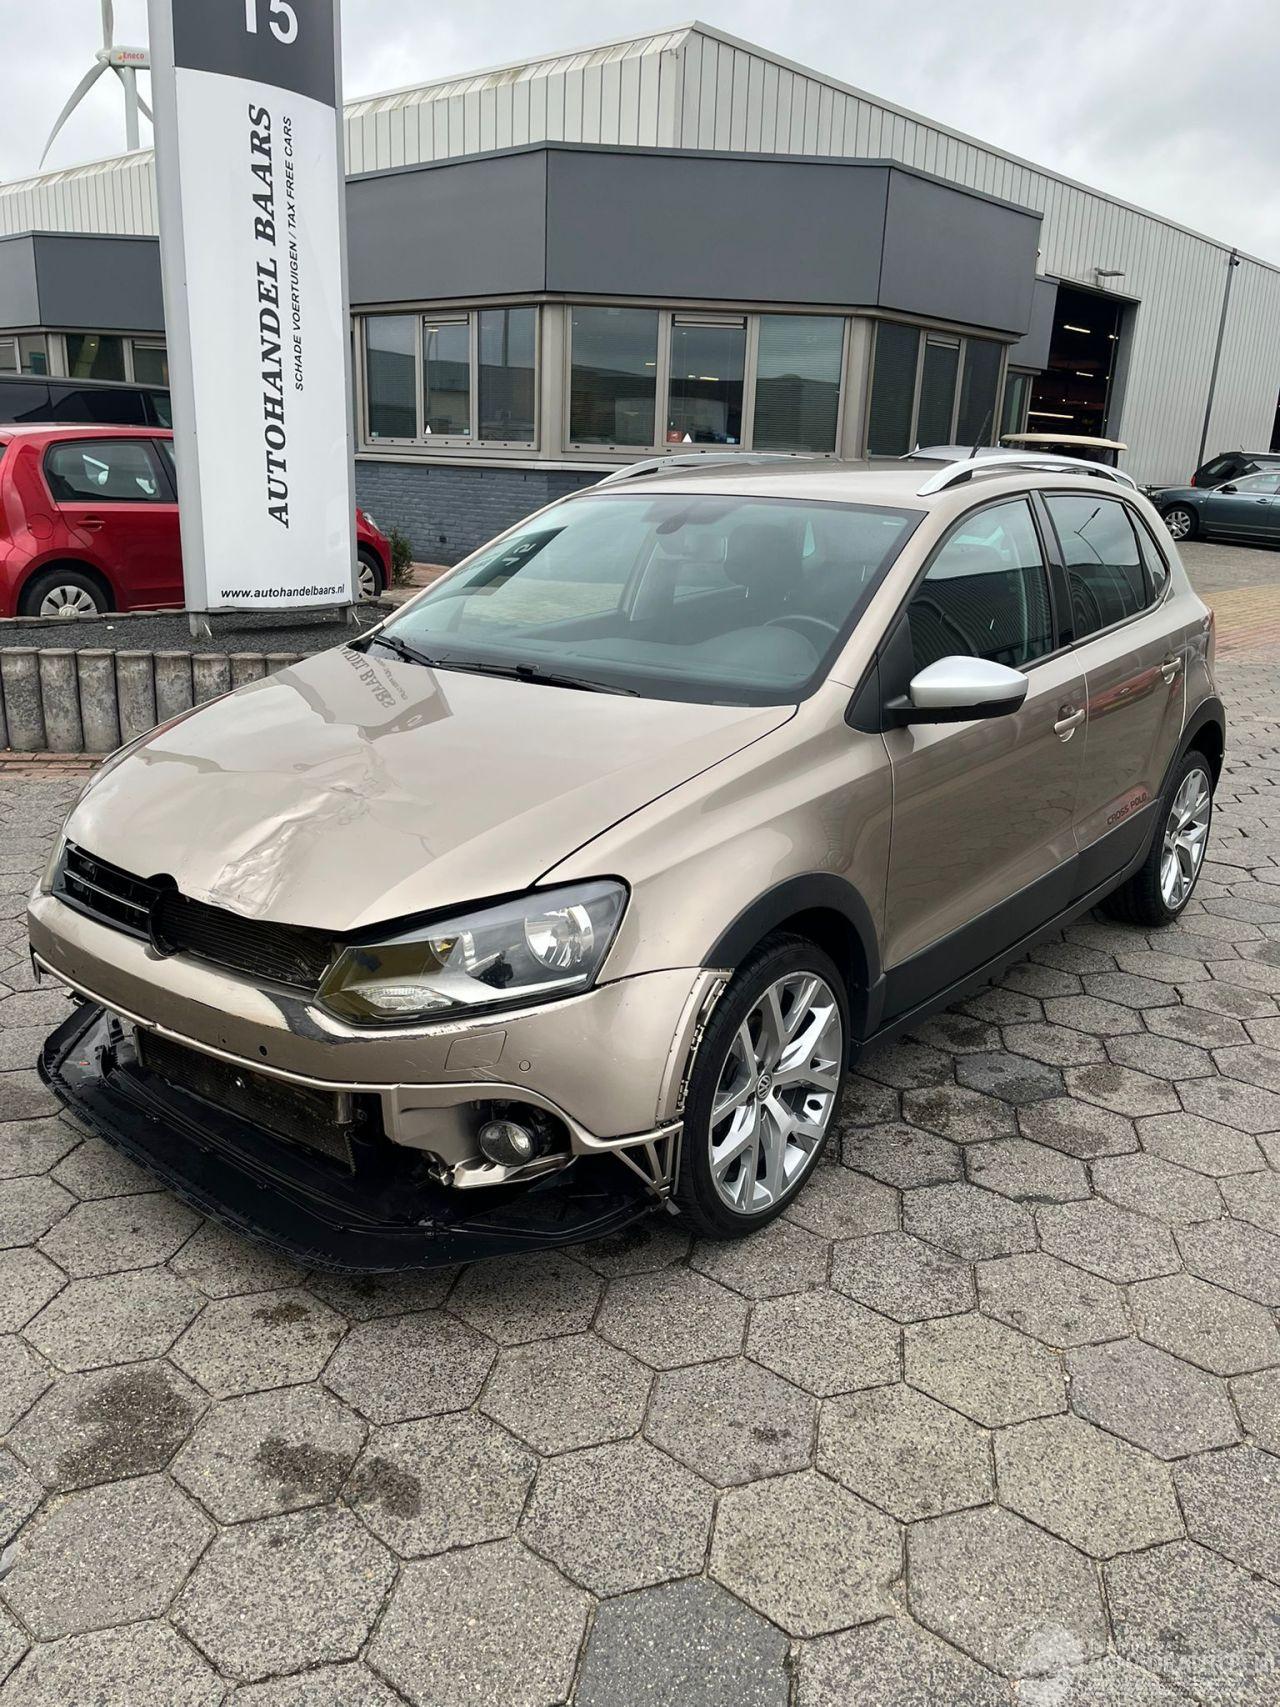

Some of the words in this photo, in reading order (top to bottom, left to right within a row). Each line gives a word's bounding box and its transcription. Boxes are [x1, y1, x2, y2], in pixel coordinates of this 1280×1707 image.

[123, 52, 145, 60] Eneco
[282, 116, 293, 157] CARS
[248, 104, 276, 247] BAARS
[284, 160, 295, 200] FREE
[286, 202, 296, 229] TAX
[288, 241, 301, 331] VOERTUIGEN
[292, 335, 304, 392] SCHADE
[256, 258, 289, 529] AUTOHANDEL
[220, 583, 345, 599] www.autohandelbaars.nl
[1106, 805, 1130, 825] CROSS
[1130, 792, 1148, 810] POLO
